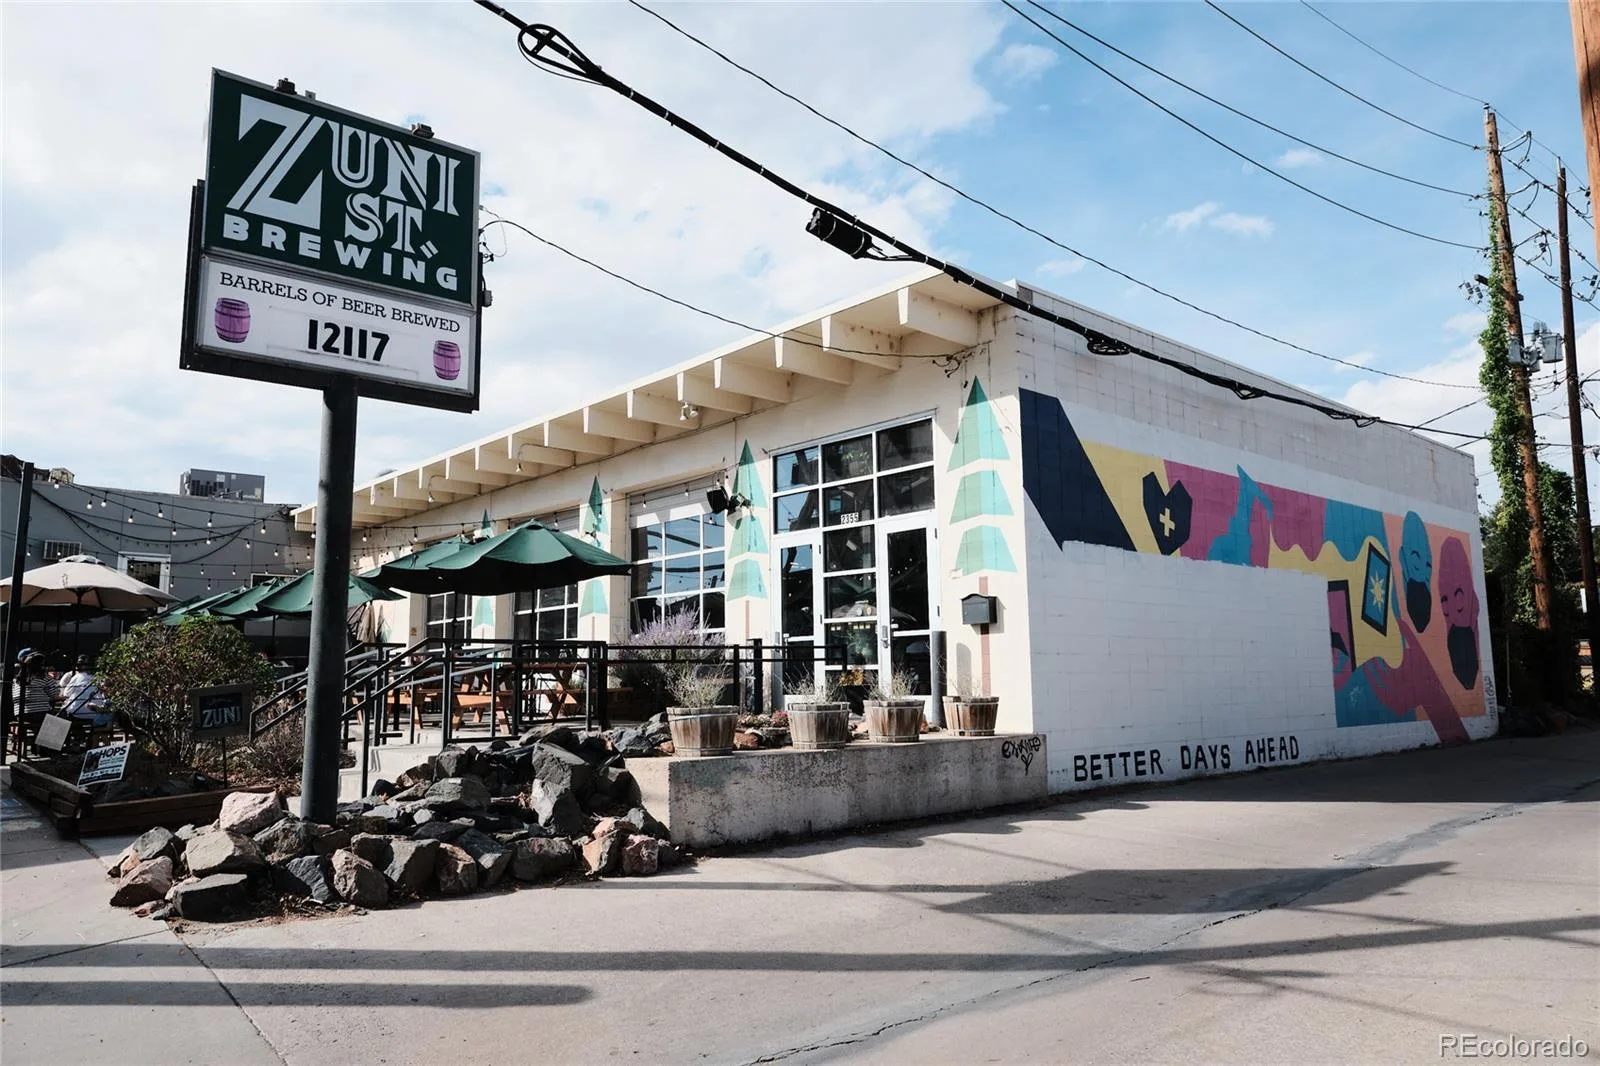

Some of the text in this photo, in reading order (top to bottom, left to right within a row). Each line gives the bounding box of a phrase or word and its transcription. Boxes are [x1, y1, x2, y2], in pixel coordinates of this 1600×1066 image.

[226, 93, 460, 230] ZUNI
[223, 213, 458, 291] BREWING
[220, 272, 460, 333] BARRELS OF BEER BREWED
[308, 319, 390, 361] 12117
[841, 512, 859, 524] 2355
[202, 706, 240, 728] ZUNI
[99, 745, 127, 758] HOPS
[1073, 735, 1299, 782] BETTER DAYS AHEAD
